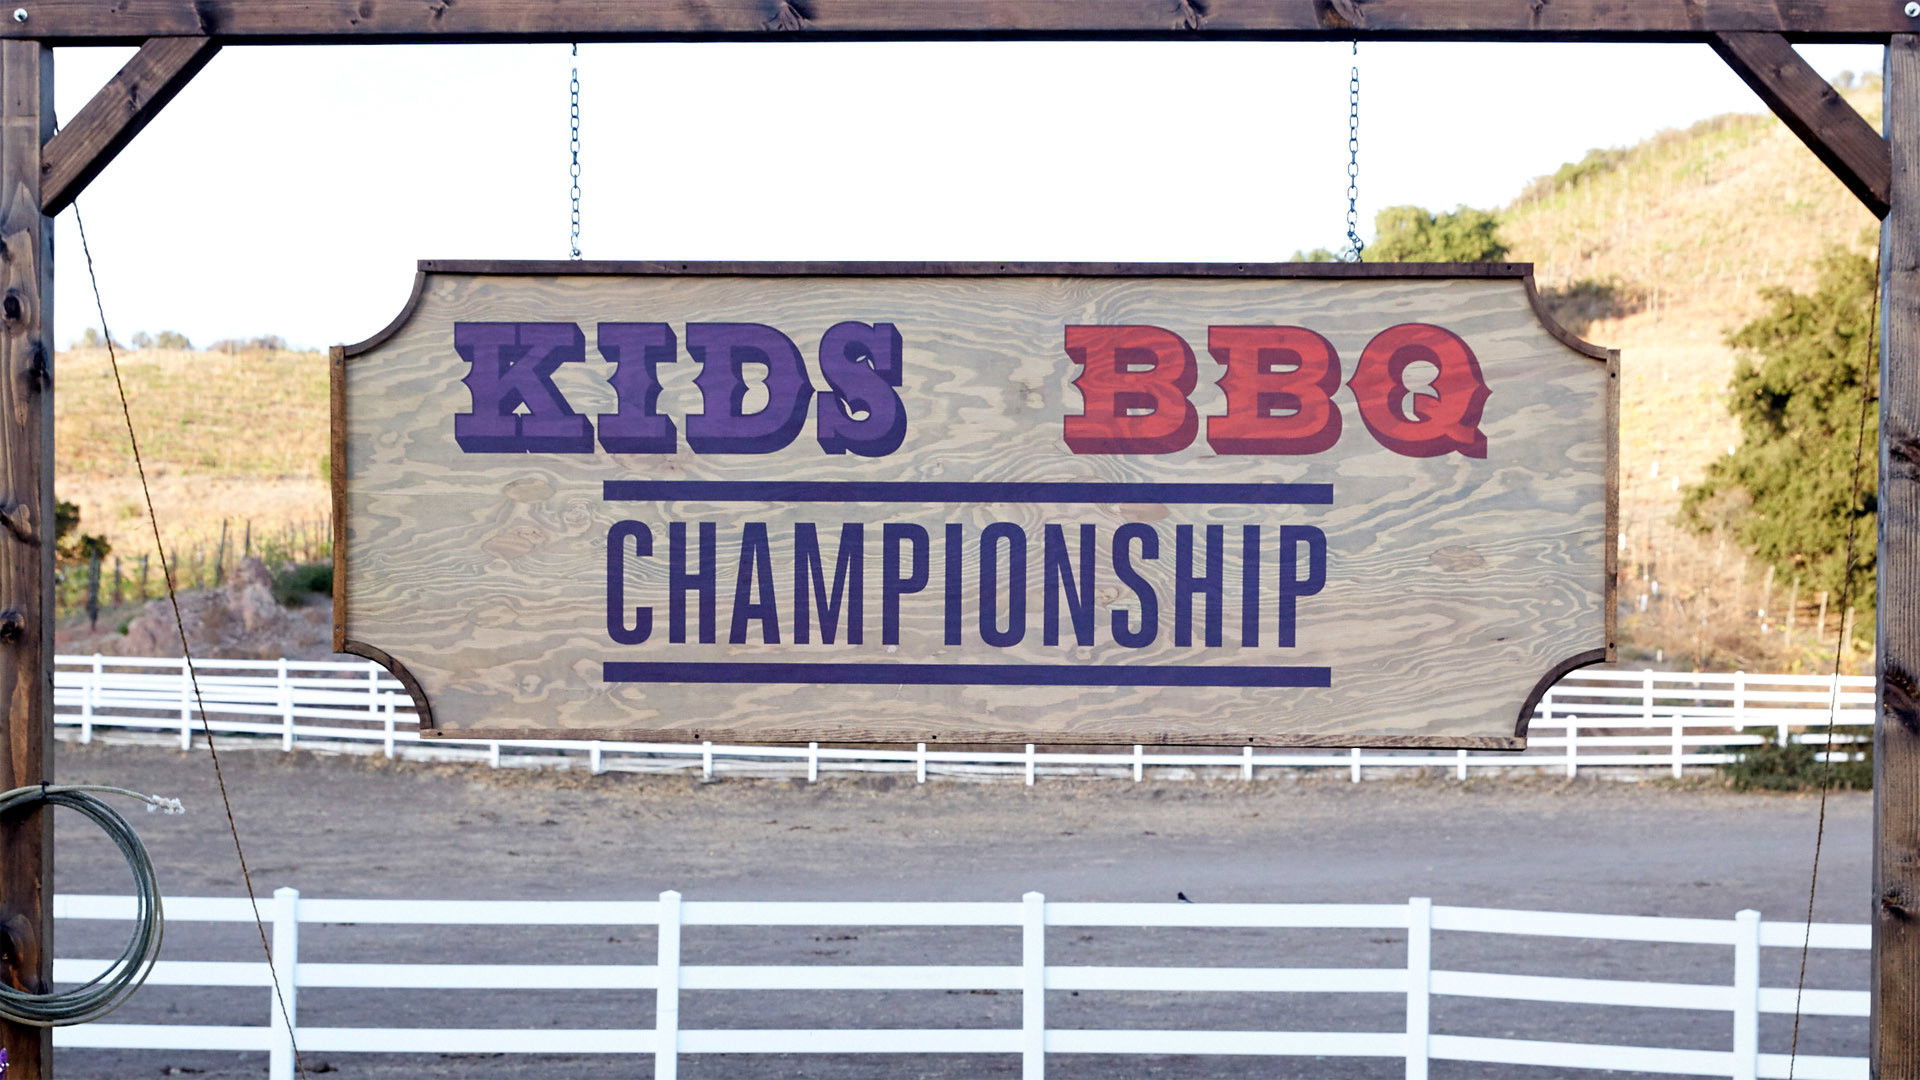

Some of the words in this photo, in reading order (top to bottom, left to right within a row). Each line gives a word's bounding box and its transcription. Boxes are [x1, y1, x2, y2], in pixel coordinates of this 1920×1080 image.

[454, 321, 907, 458] KIDS
[1063, 322, 1493, 459] BBQ
[606, 519, 1328, 649] CHAMPIONSHIP
